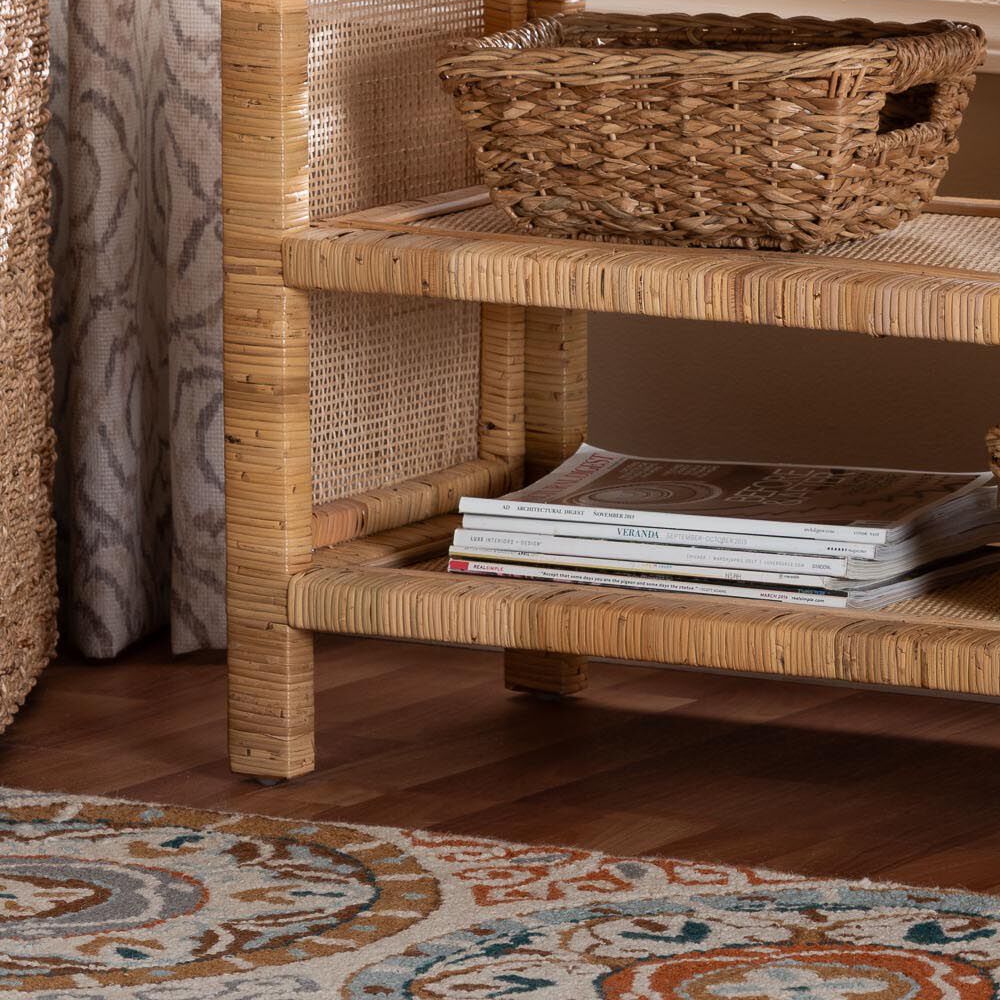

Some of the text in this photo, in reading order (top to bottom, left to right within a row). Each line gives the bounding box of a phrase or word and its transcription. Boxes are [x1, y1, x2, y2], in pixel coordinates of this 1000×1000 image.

[517, 506, 562, 515] ARCHITECTURAL
[593, 511, 624, 519] NOVEMBER
[616, 528, 660, 540] VERANDA
